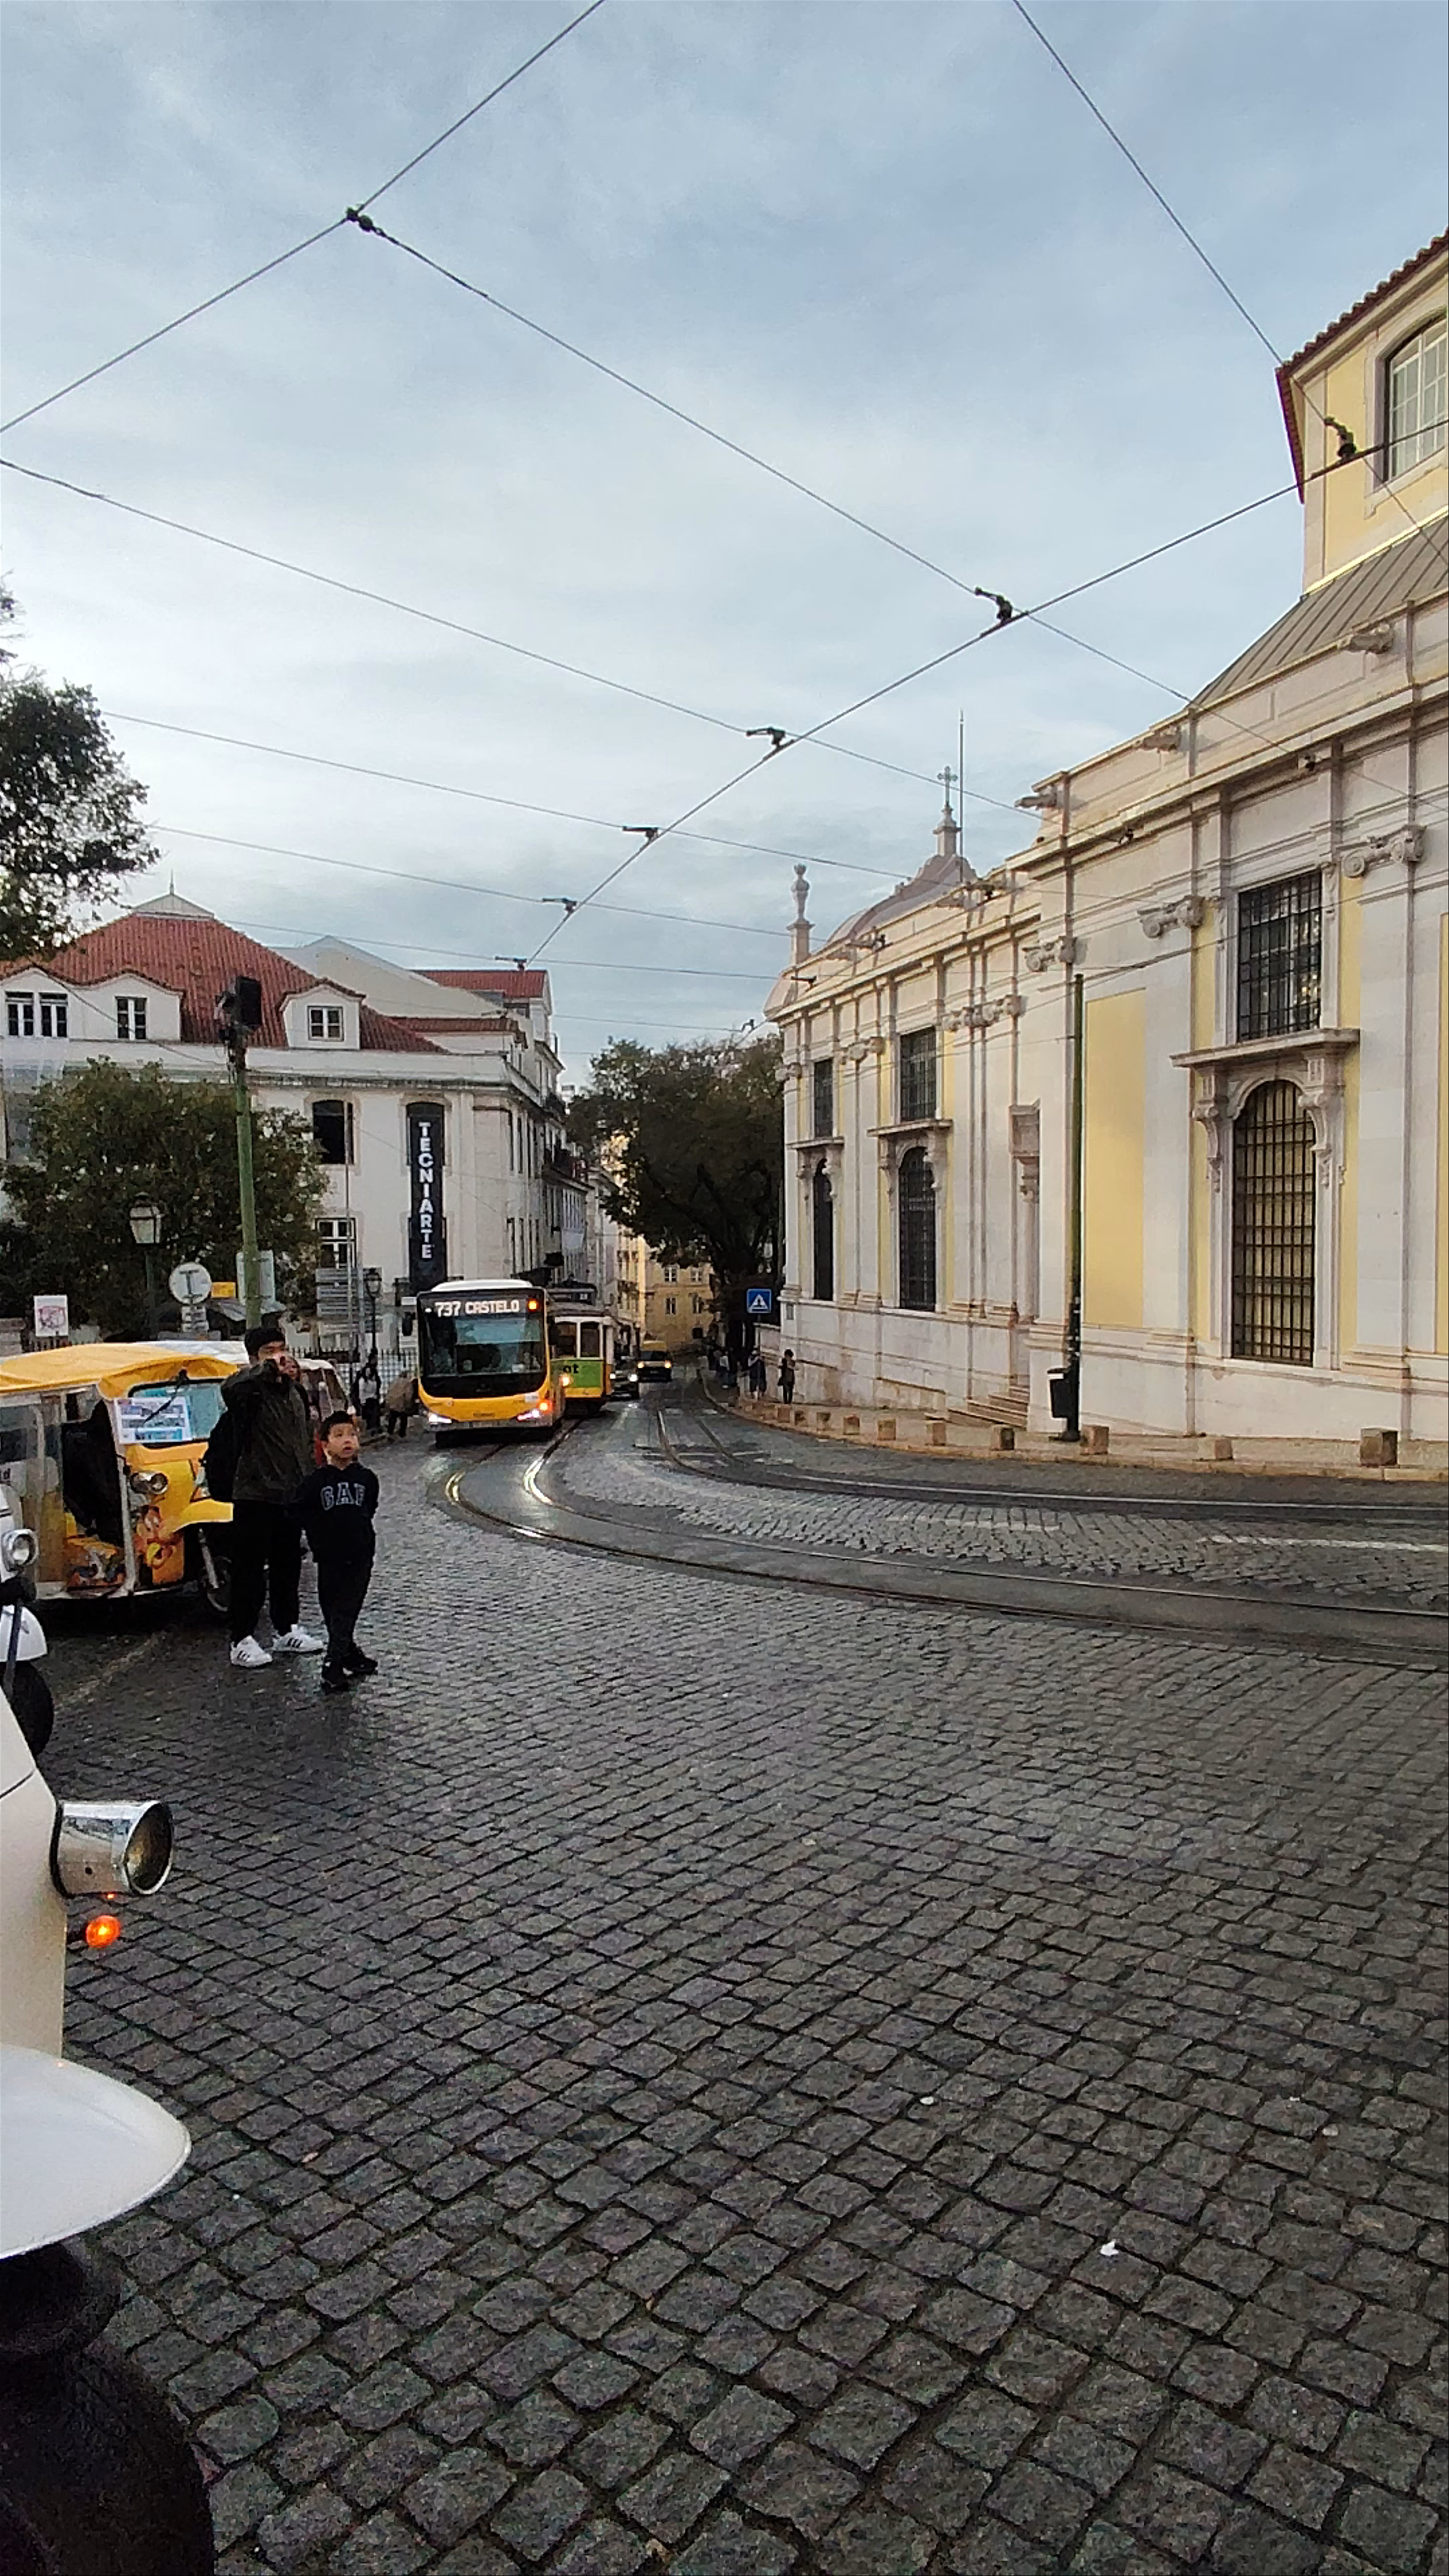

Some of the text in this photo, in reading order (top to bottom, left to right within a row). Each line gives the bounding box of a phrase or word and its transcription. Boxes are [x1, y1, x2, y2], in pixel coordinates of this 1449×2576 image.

[418, 1122, 434, 1258] TECNIARTE
[435, 1300, 519, 1317] 737 CASTELO
